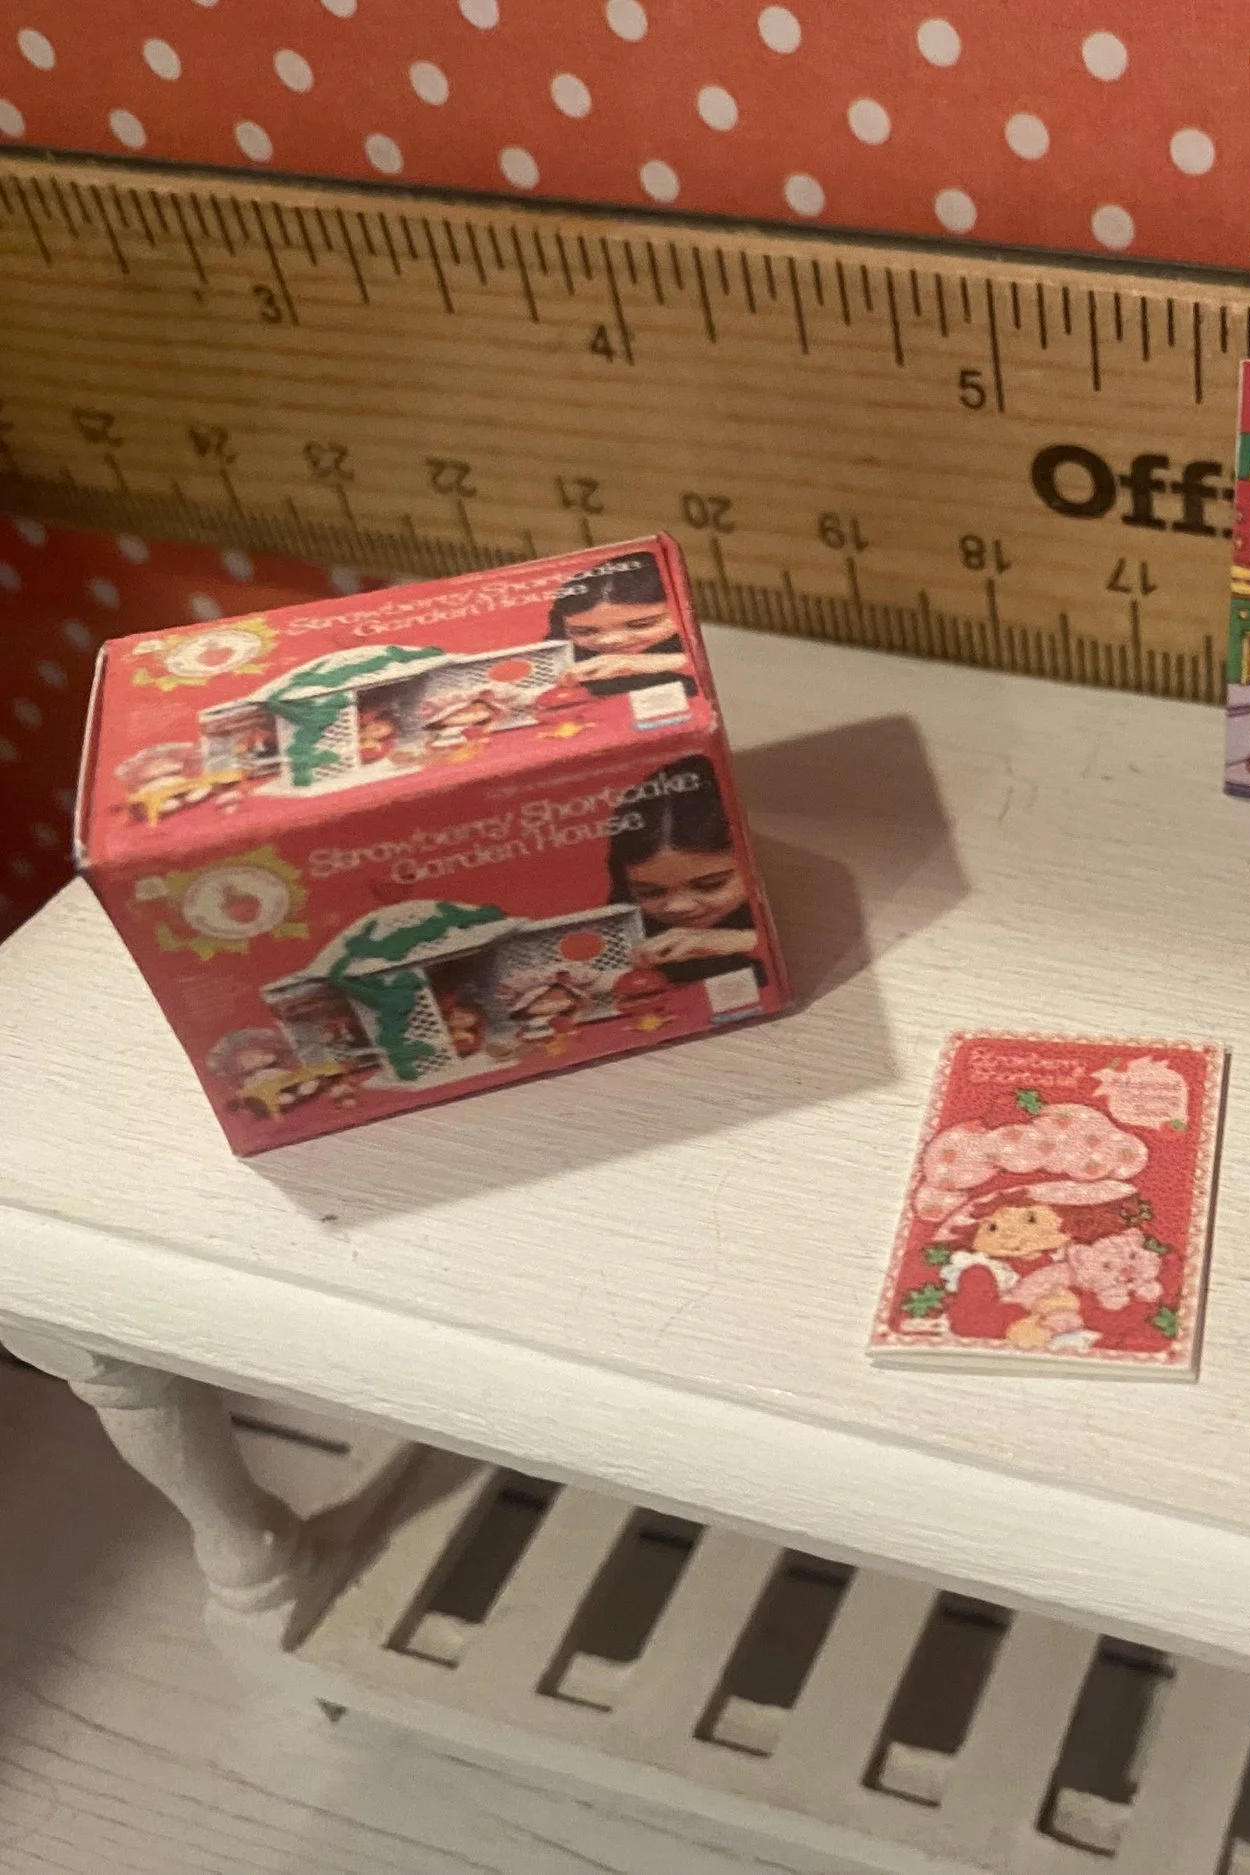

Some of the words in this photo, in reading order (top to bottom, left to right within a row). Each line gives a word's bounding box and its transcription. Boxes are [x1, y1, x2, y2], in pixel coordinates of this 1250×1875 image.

[253, 284, 283, 325] 3
[588, 322, 615, 363] 4
[958, 368, 987, 410] 5
[555, 474, 604, 516] 21
[680, 490, 737, 534] 20
[817, 512, 870, 553] 19
[958, 534, 1012, 576] 18
[1106, 556, 1158, 597] 17
[1030, 443, 1235, 541] Off
[520, 769, 701, 829] Shortcake
[531, 811, 647, 853] House
